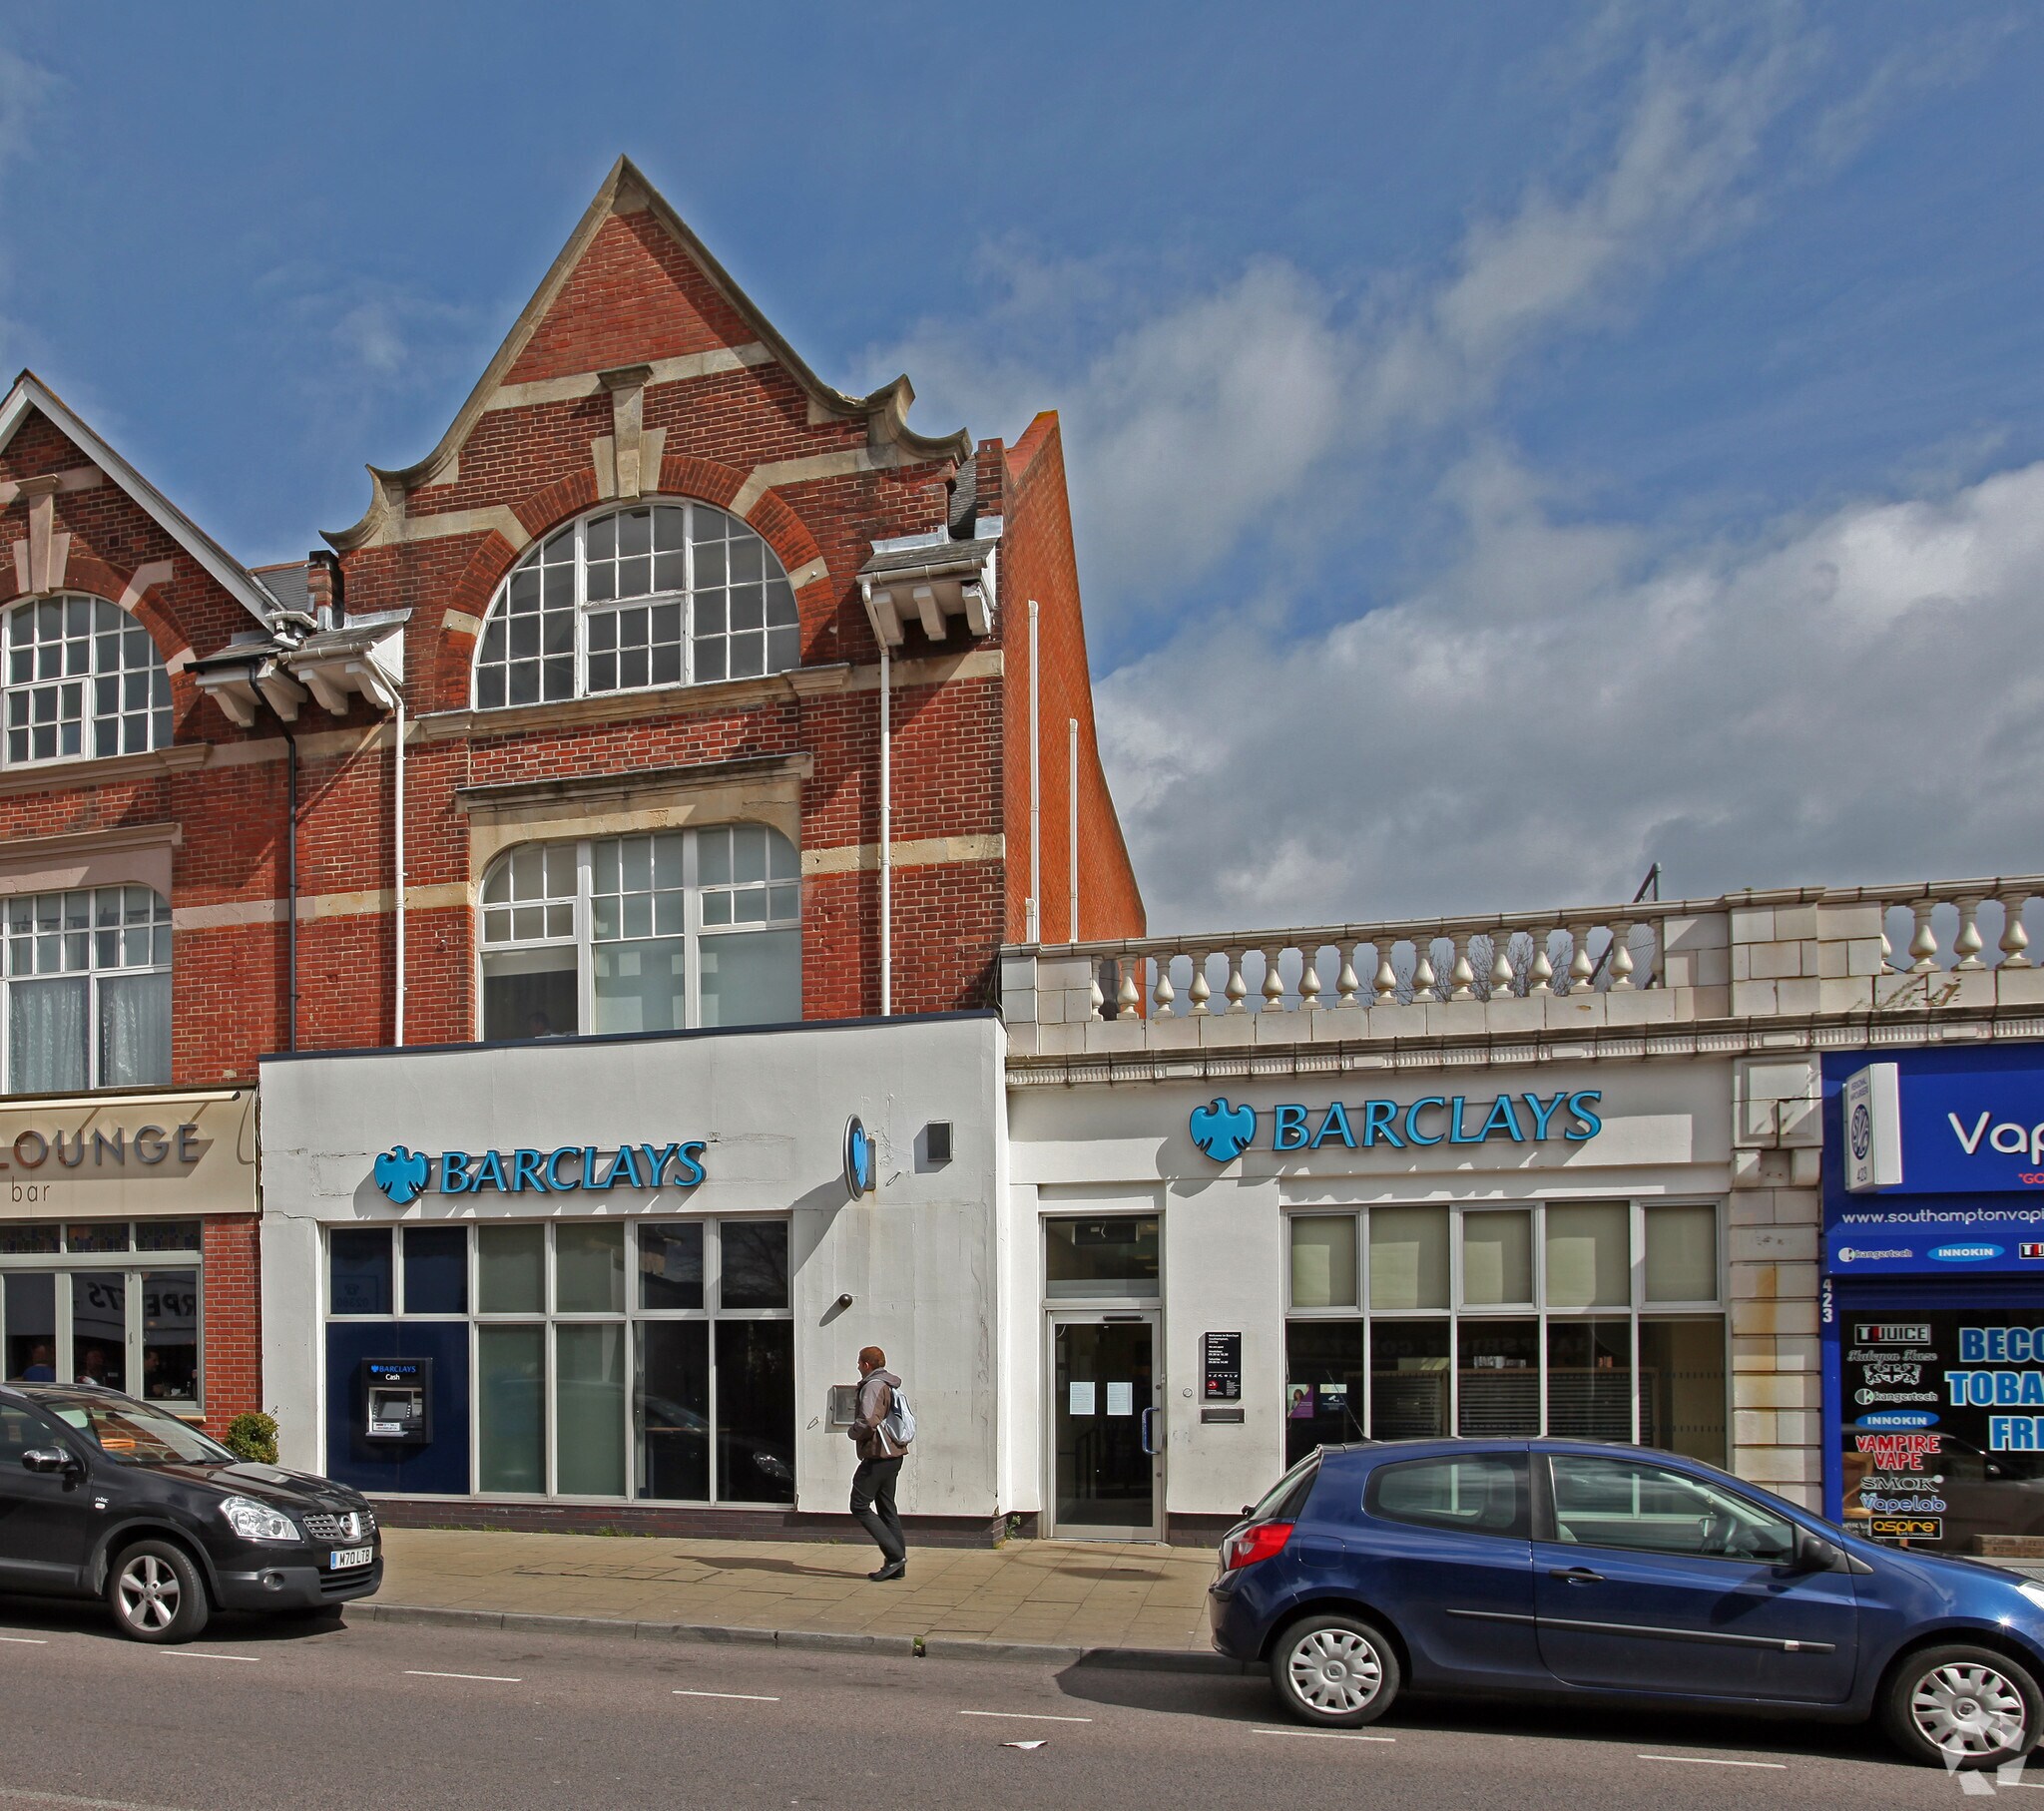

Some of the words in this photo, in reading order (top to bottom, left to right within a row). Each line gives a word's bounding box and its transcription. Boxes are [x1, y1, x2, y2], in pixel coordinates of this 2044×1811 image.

[1273, 1090, 1603, 1151] BARCLAYS
[440, 1140, 708, 1194] BARCLAYS
[11, 1175, 50, 1202] bar
[1938, 1248, 1994, 1257] INNOKIN
[1874, 1391, 1938, 1403] kangertech
[1855, 1435, 1941, 1454] VAMPIRE
[1874, 1452, 1924, 1470] VAPE
[1860, 1476, 1940, 1493] SMOK
[1859, 1492, 1946, 1515] Vapelab
[1873, 1520, 1935, 1534] aspire
[356, 1549, 370, 1564] LTB
